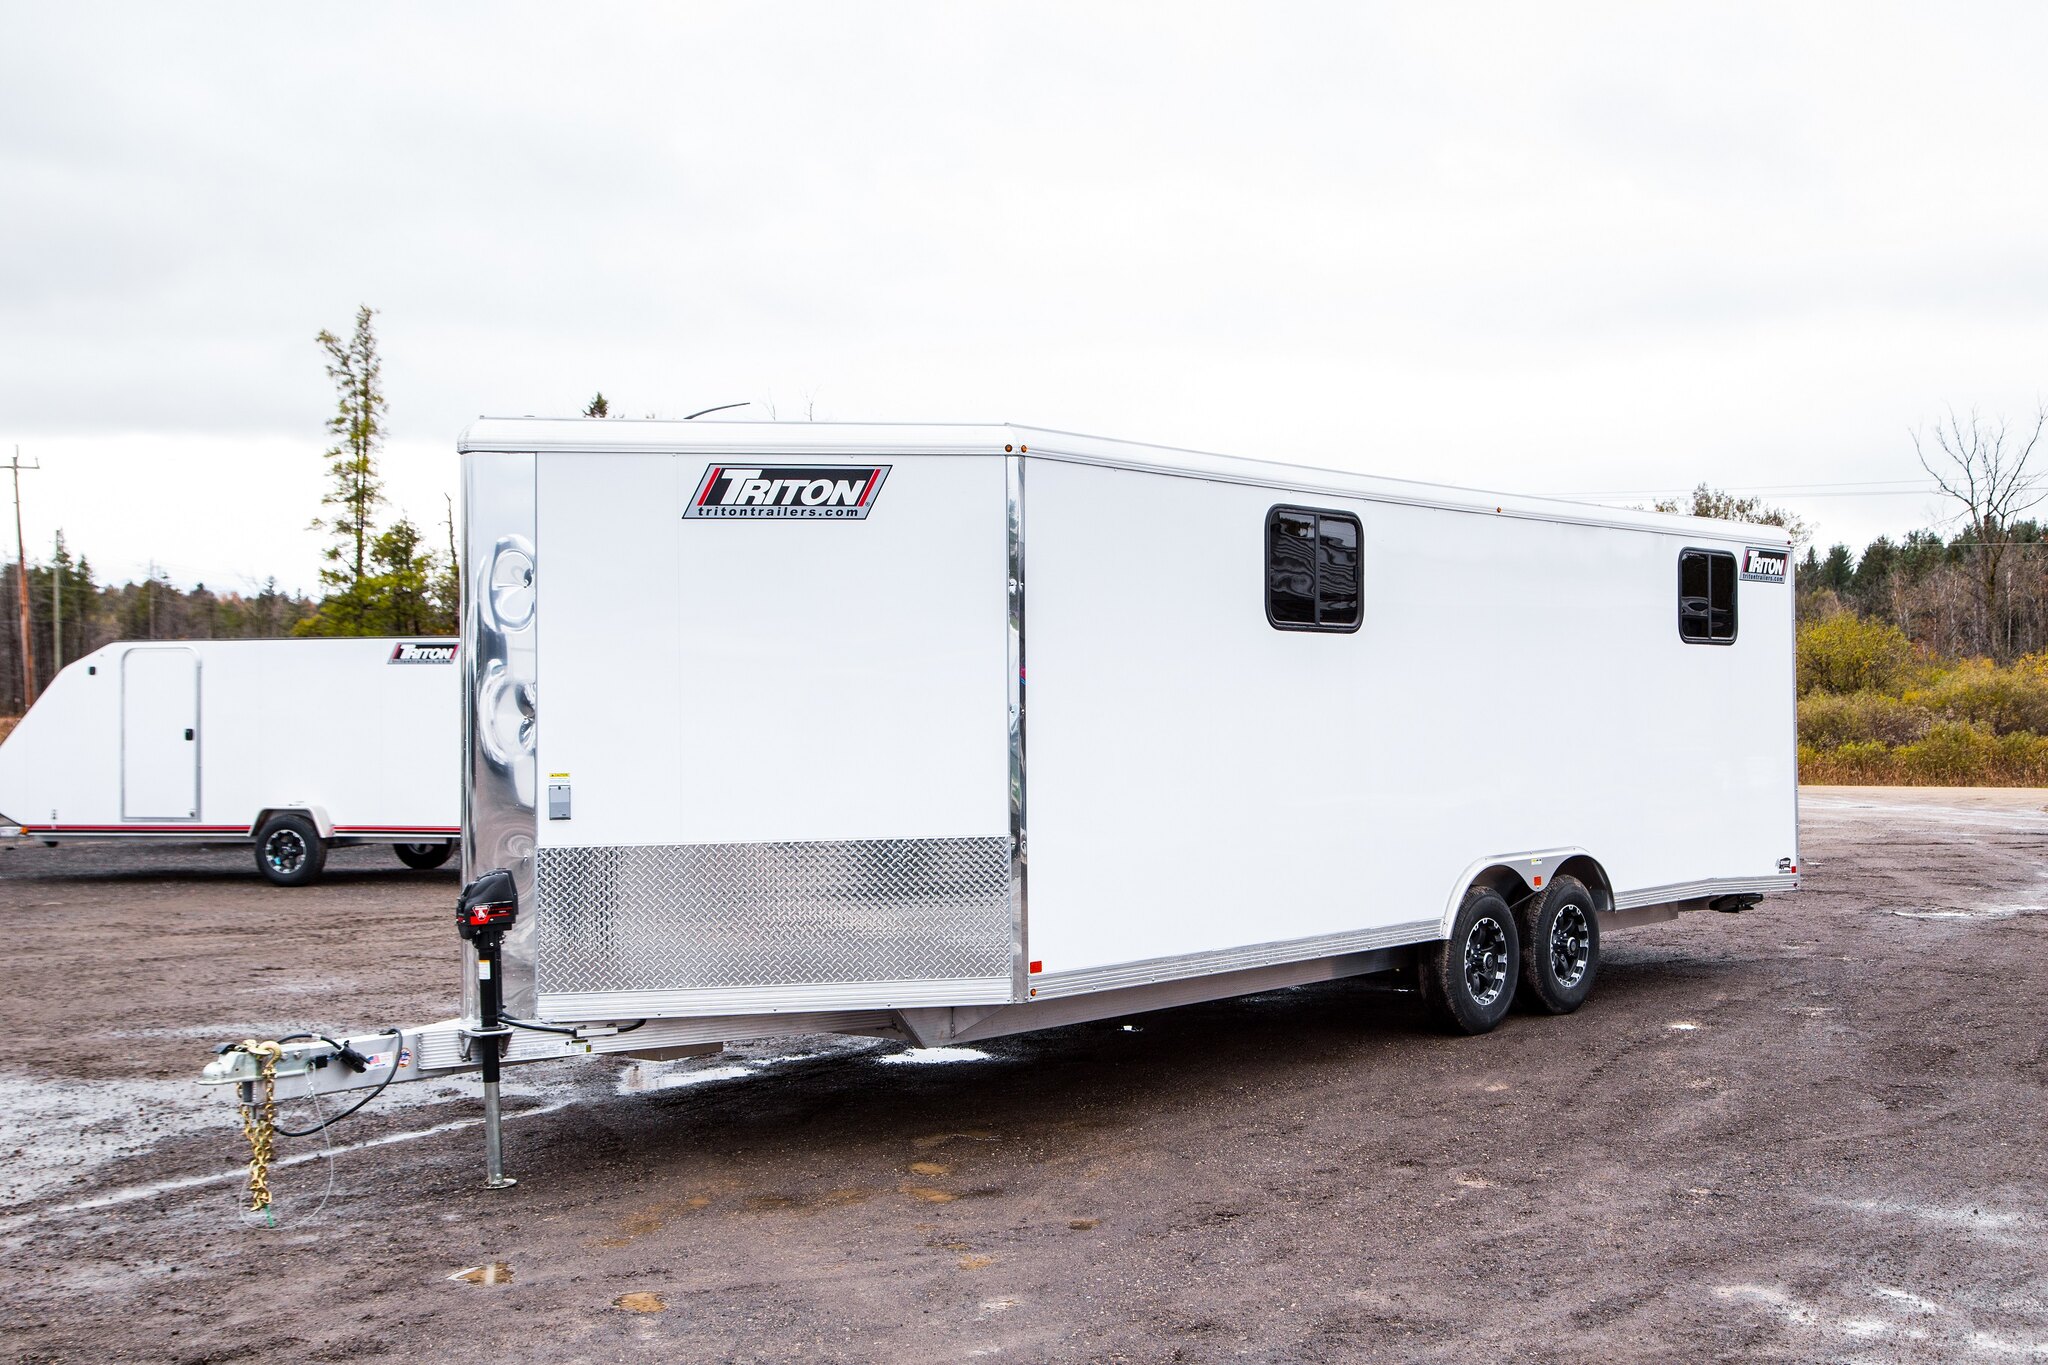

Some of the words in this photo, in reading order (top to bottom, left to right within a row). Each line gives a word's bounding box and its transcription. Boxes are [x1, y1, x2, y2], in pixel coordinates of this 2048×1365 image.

[720, 469, 866, 505] TRITON
[698, 507, 858, 517] tritontrailers.com
[1748, 550, 1785, 575] TRITON
[400, 644, 454, 659] TRITON
